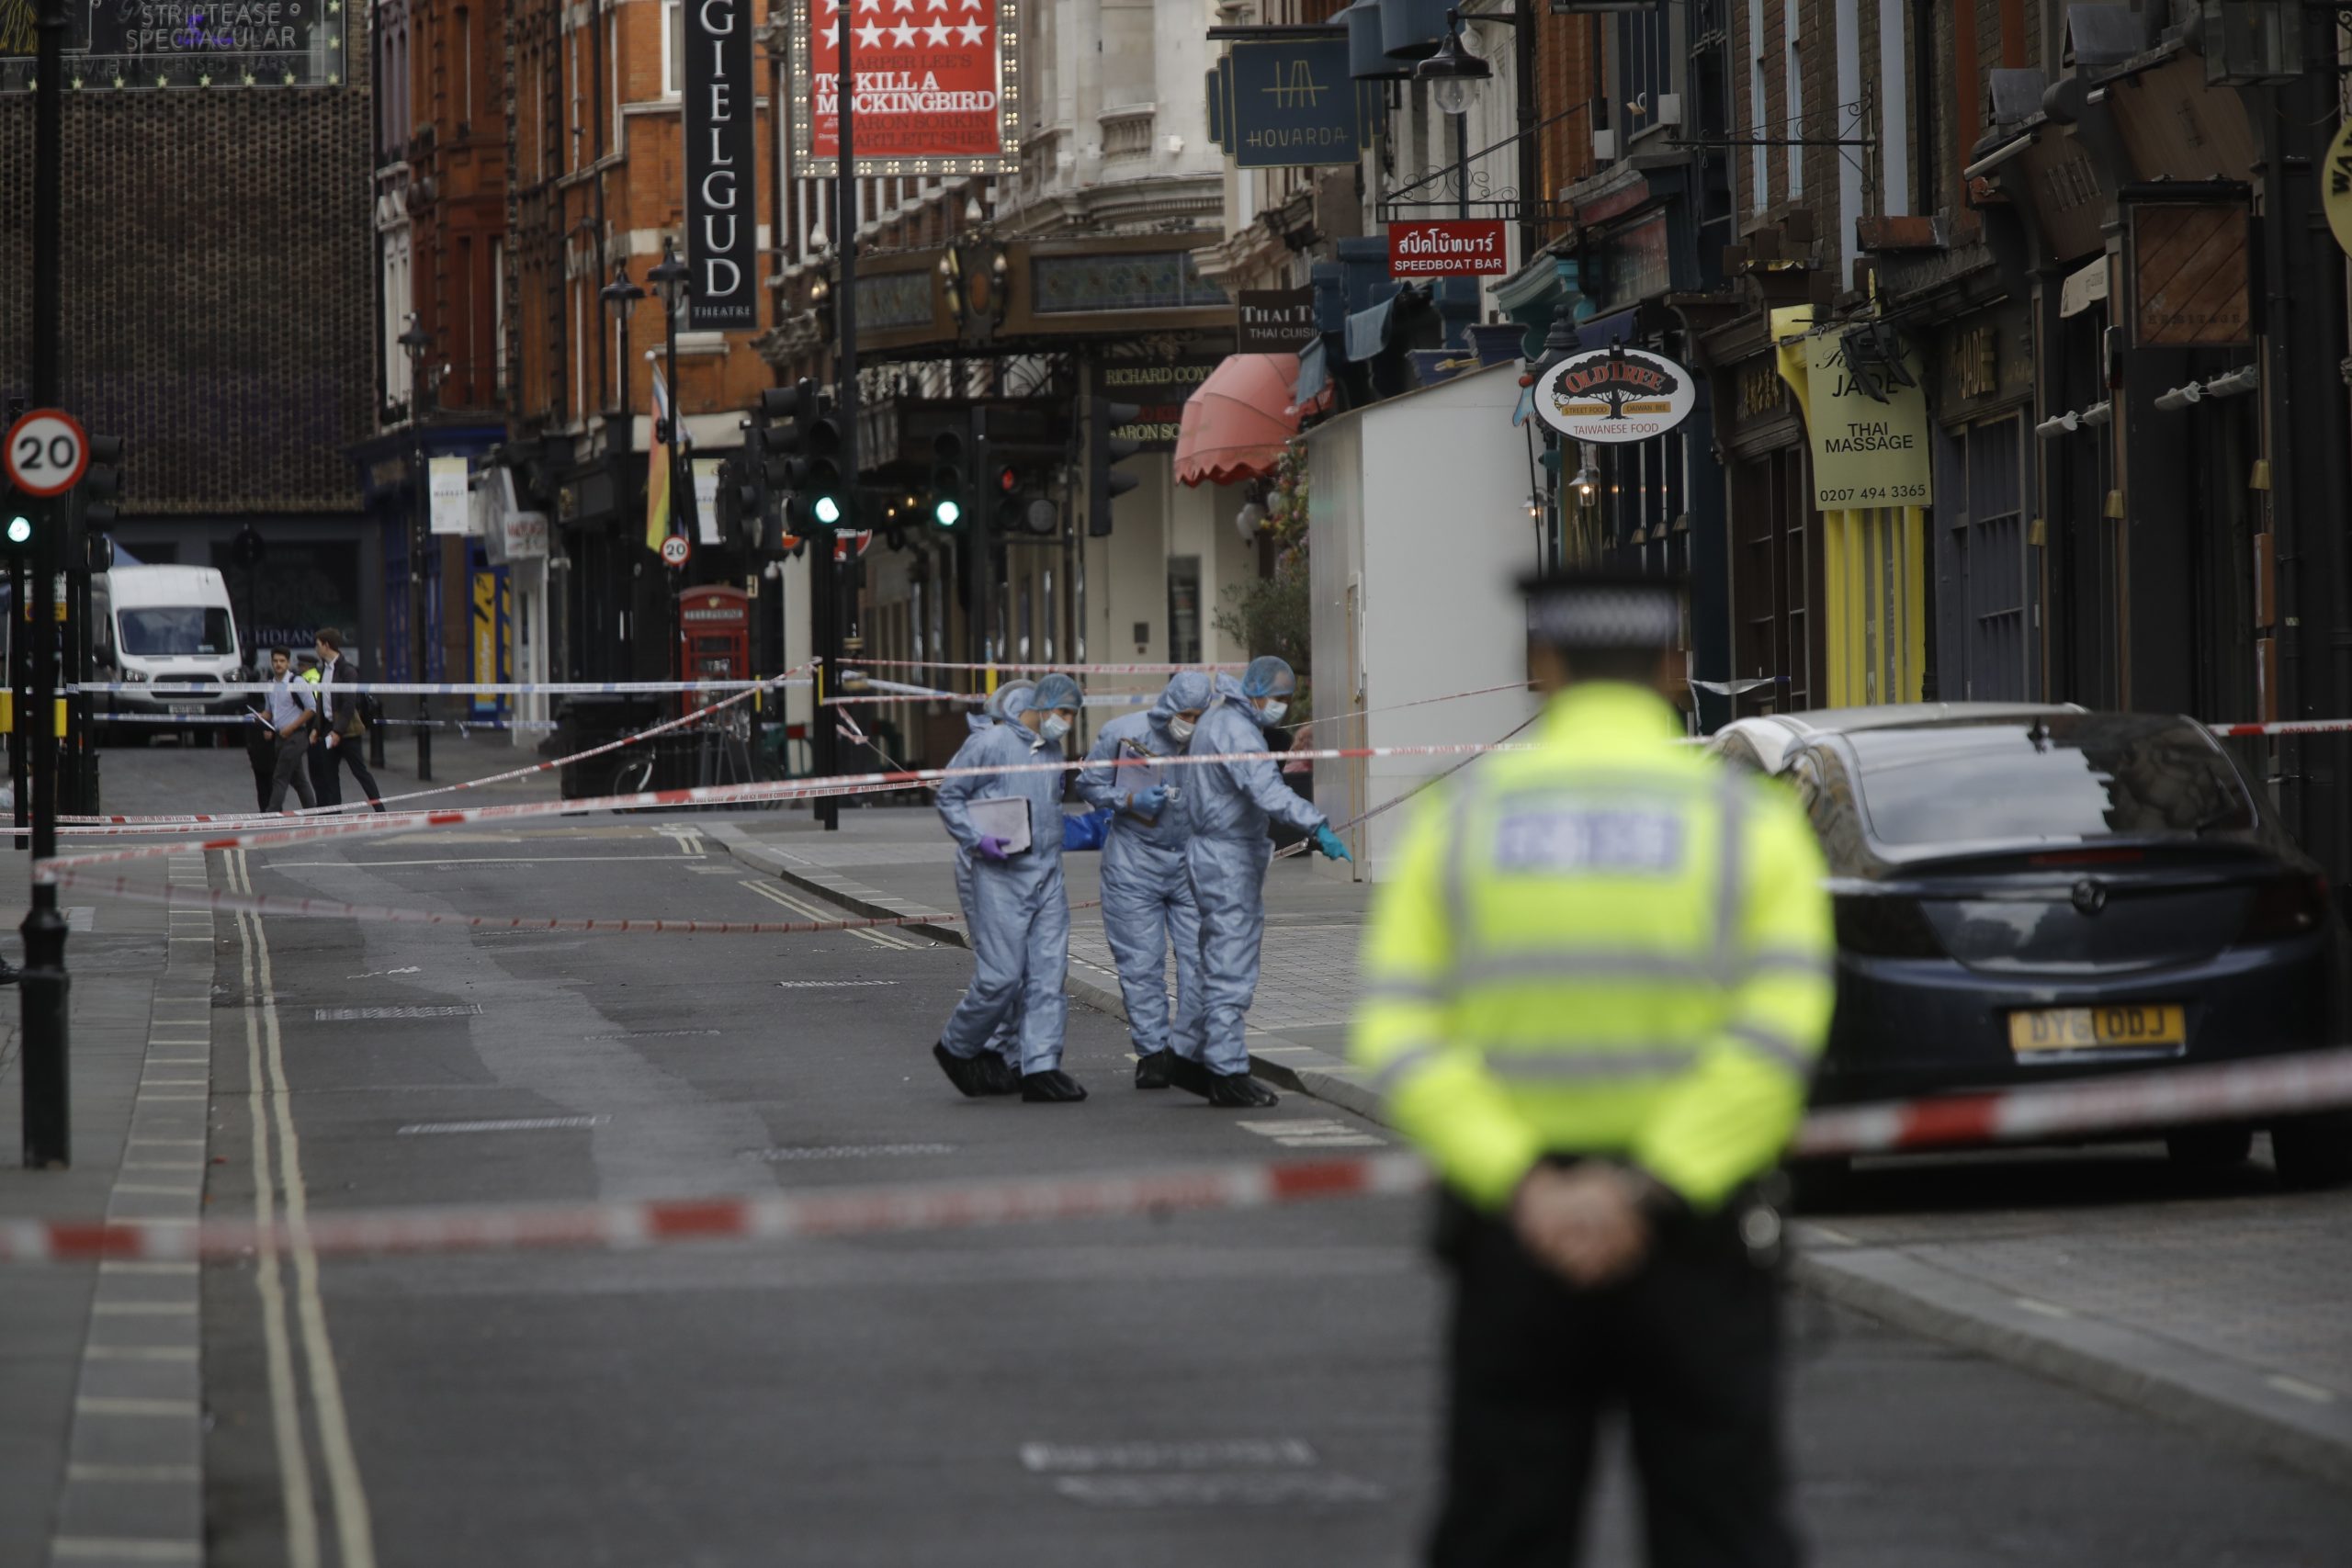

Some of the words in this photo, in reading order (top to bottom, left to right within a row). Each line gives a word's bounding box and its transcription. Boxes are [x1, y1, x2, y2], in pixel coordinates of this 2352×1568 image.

[141, 3, 281, 28] STRIPTEASE
[125, 26, 297, 52] SPECTACULAR
[853, 55, 916, 70] ARPER
[921, 53, 973, 68] LEE'S
[854, 71, 918, 93] KILL
[921, 71, 940, 92] A
[816, 91, 996, 116] MCKINGBIRD
[854, 115, 909, 130] ARON
[913, 114, 989, 129] SORKIN
[853, 132, 938, 147] ARTLETT
[942, 130, 993, 146] SHER
[1247, 127, 1349, 148] HOVARDA
[699, 0, 742, 298] GIELGUD
[1395, 258, 1472, 271] SPEEDBOAT
[1475, 258, 1502, 269] BAR
[694, 306, 752, 318] THEATRE
[1241, 305, 1290, 322] THAI
[1250, 327, 1278, 339] THAI
[1281, 327, 1318, 338] CUISI
[1105, 367, 1172, 386] RICHARD
[1174, 366, 1214, 382] COY
[1565, 365, 1609, 393] OLD
[1607, 360, 1667, 392] TREE
[1565, 406, 1587, 414] STREET
[1589, 405, 1608, 413] FOOD
[1626, 404, 1653, 412] DAIWAN
[1574, 423, 1627, 435] TAIWANESE
[1631, 423, 1659, 434] FOOD
[1848, 421, 1889, 437] THAI
[20, 436, 74, 469] 20
[1826, 434, 1913, 454] MASSAGE
[1820, 489, 1854, 502] 0207
[1860, 486, 1885, 501] 494
[1891, 484, 1926, 498] 3365
[666, 543, 685, 556] 20
